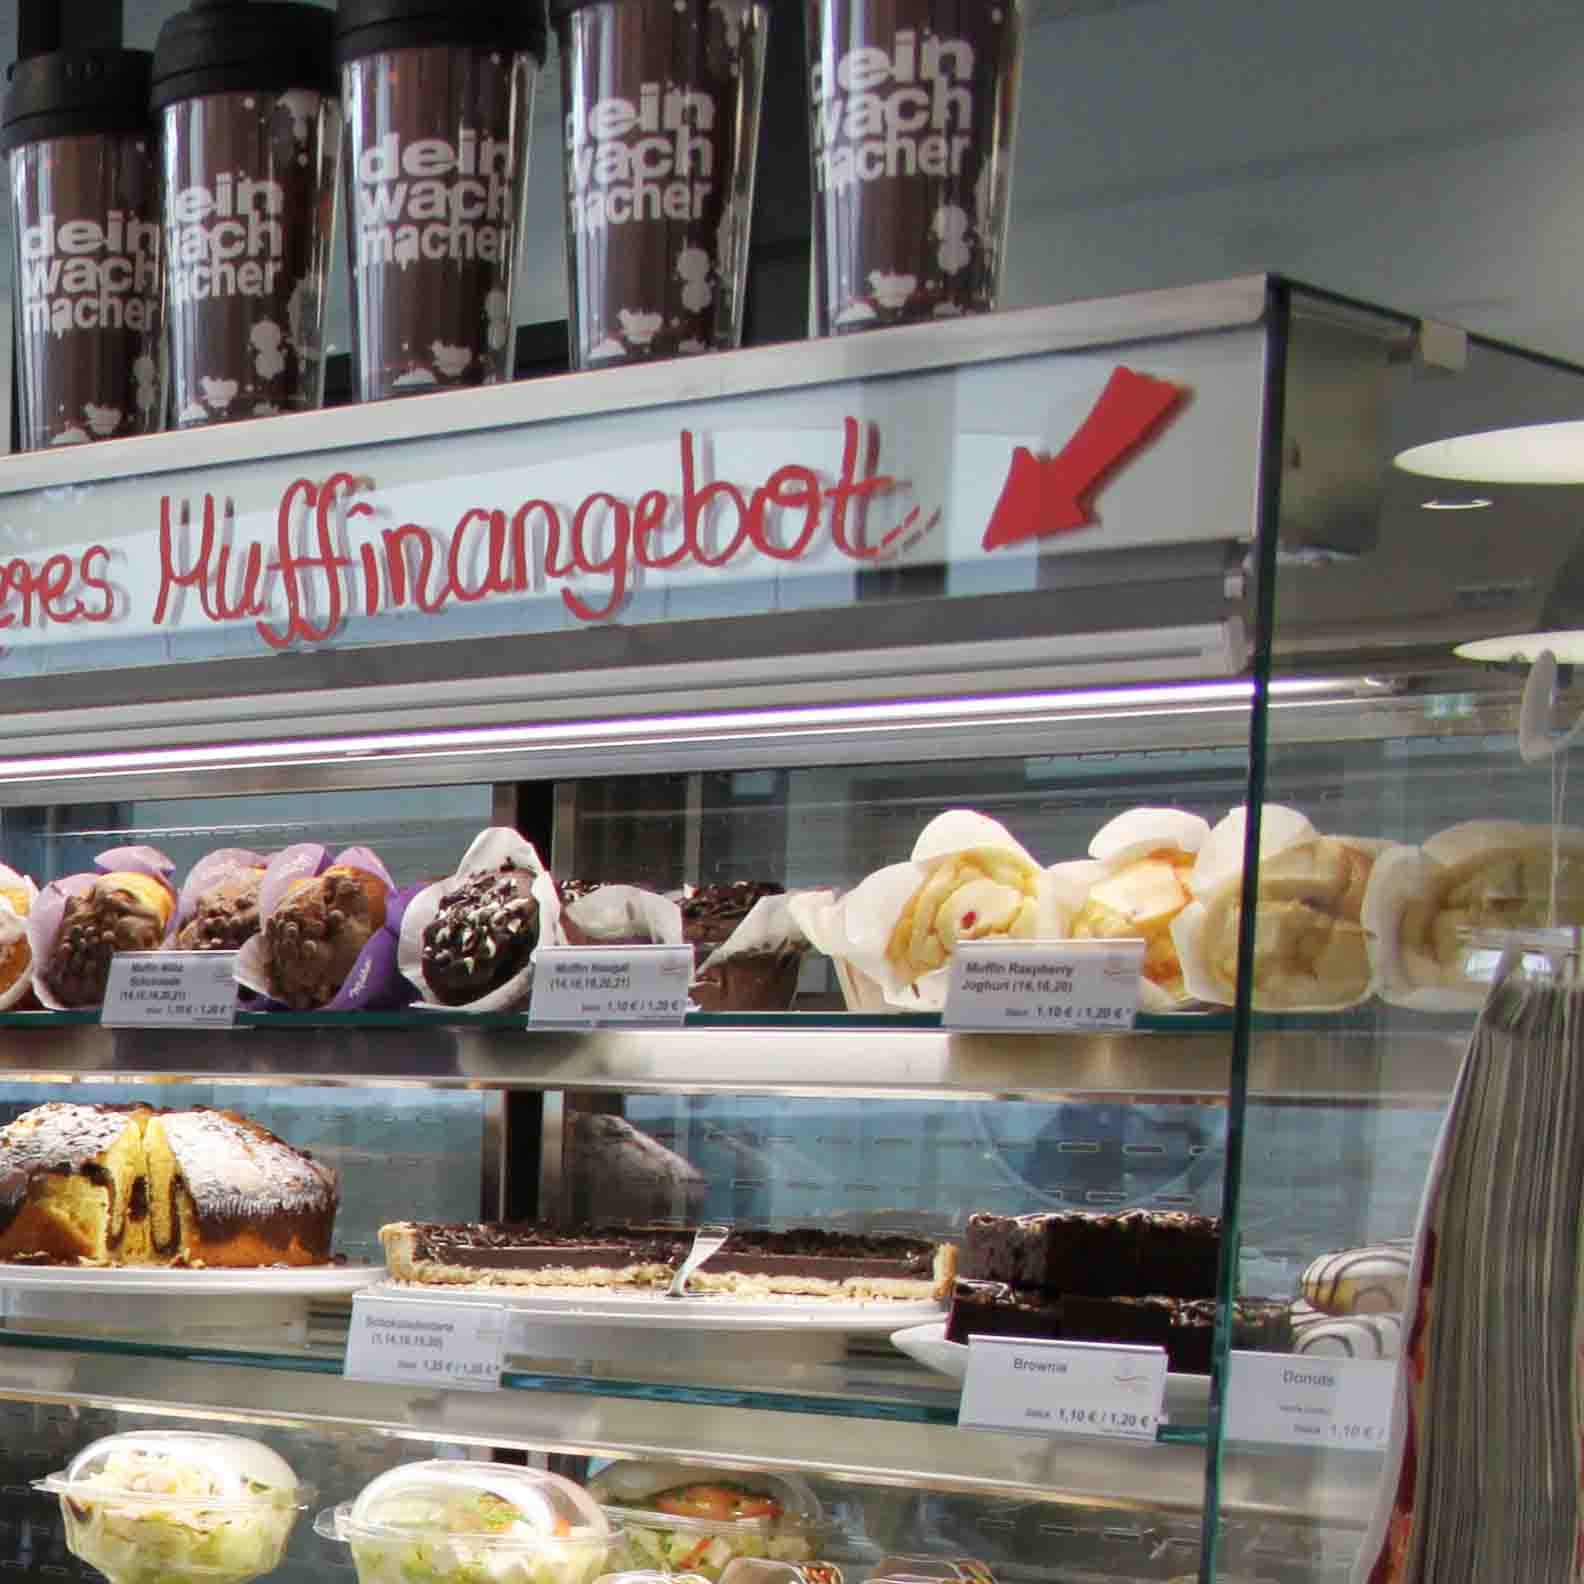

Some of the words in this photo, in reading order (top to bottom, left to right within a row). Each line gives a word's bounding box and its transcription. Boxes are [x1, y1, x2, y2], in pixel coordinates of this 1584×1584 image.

[358, 129, 513, 182] dein
[362, 175, 513, 221] wach
[22, 208, 161, 257] dein
[24, 250, 161, 296] wach
[23, 292, 160, 333] macher
[153, 415, 922, 650] Muffinangebot
[965, 961, 1006, 975] Muffin
[1007, 962, 1074, 977] Raspberry
[1013, 1358, 1068, 1374] Brownie
[1282, 1369, 1335, 1386] Donuts
[1058, 1408, 1085, 1425] 1,10
[1111, 1412, 1137, 1427] 1,20
